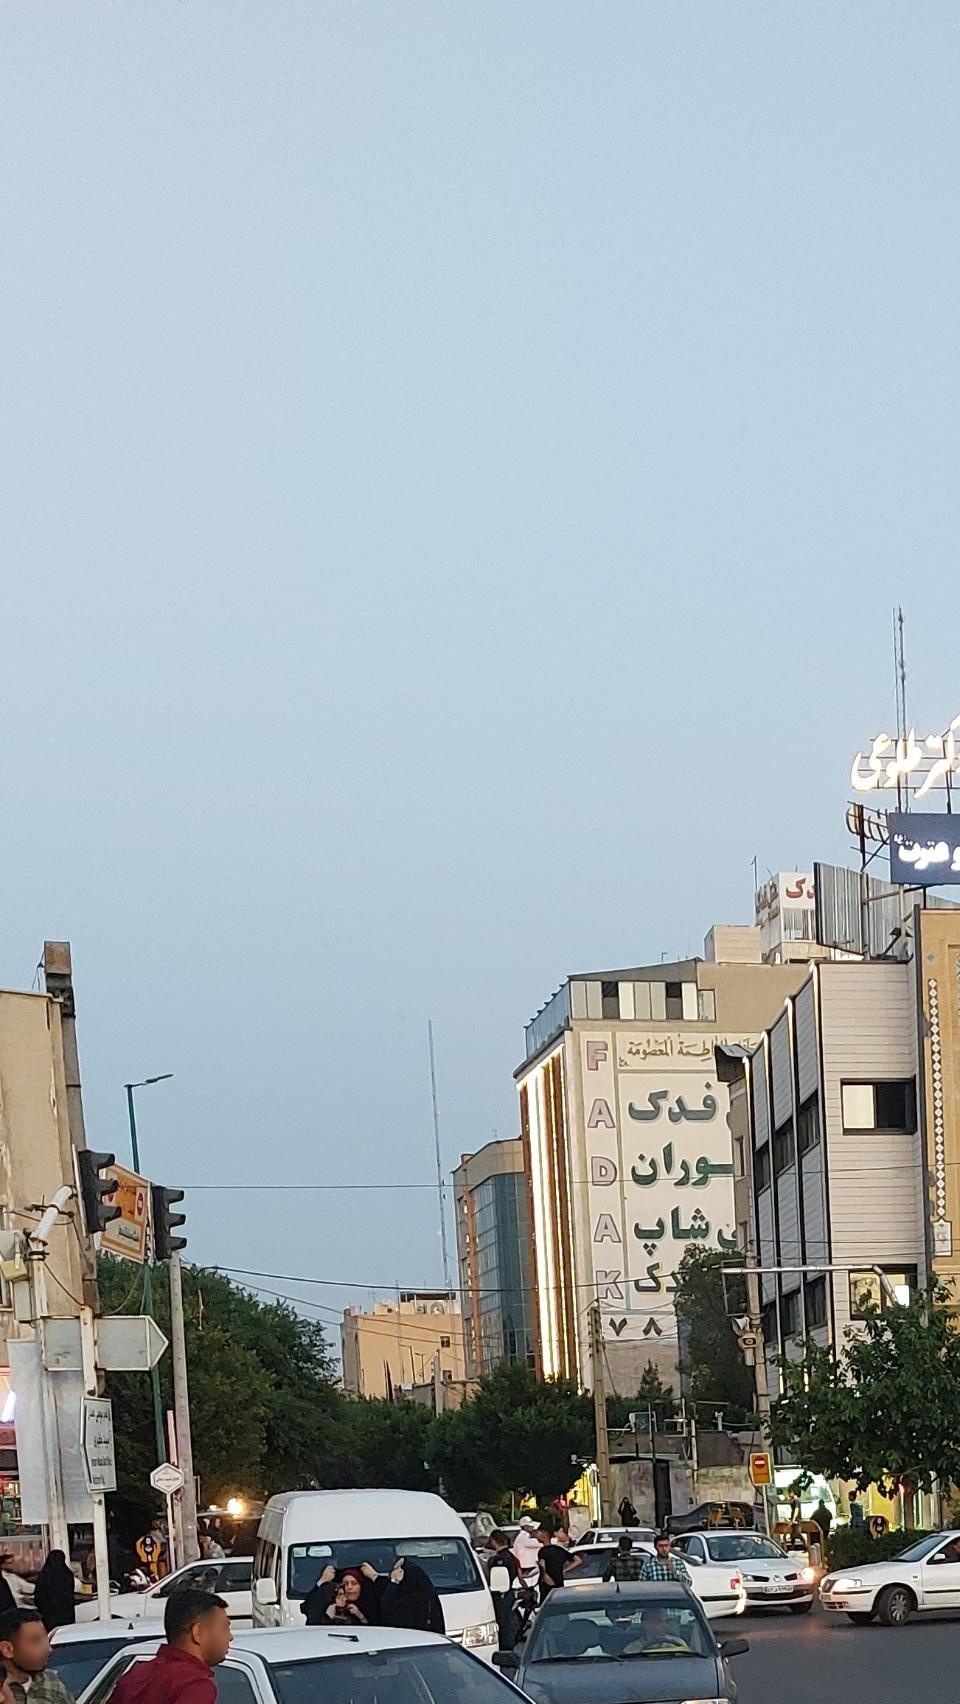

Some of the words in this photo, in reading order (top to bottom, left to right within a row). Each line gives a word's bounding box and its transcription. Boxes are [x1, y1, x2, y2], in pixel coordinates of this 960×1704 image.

[898, 841, 950, 870] عترت
[628, 1081, 717, 1123] فدک
[631, 1141, 735, 1187] وران
[633, 1206, 711, 1257] شاپ
